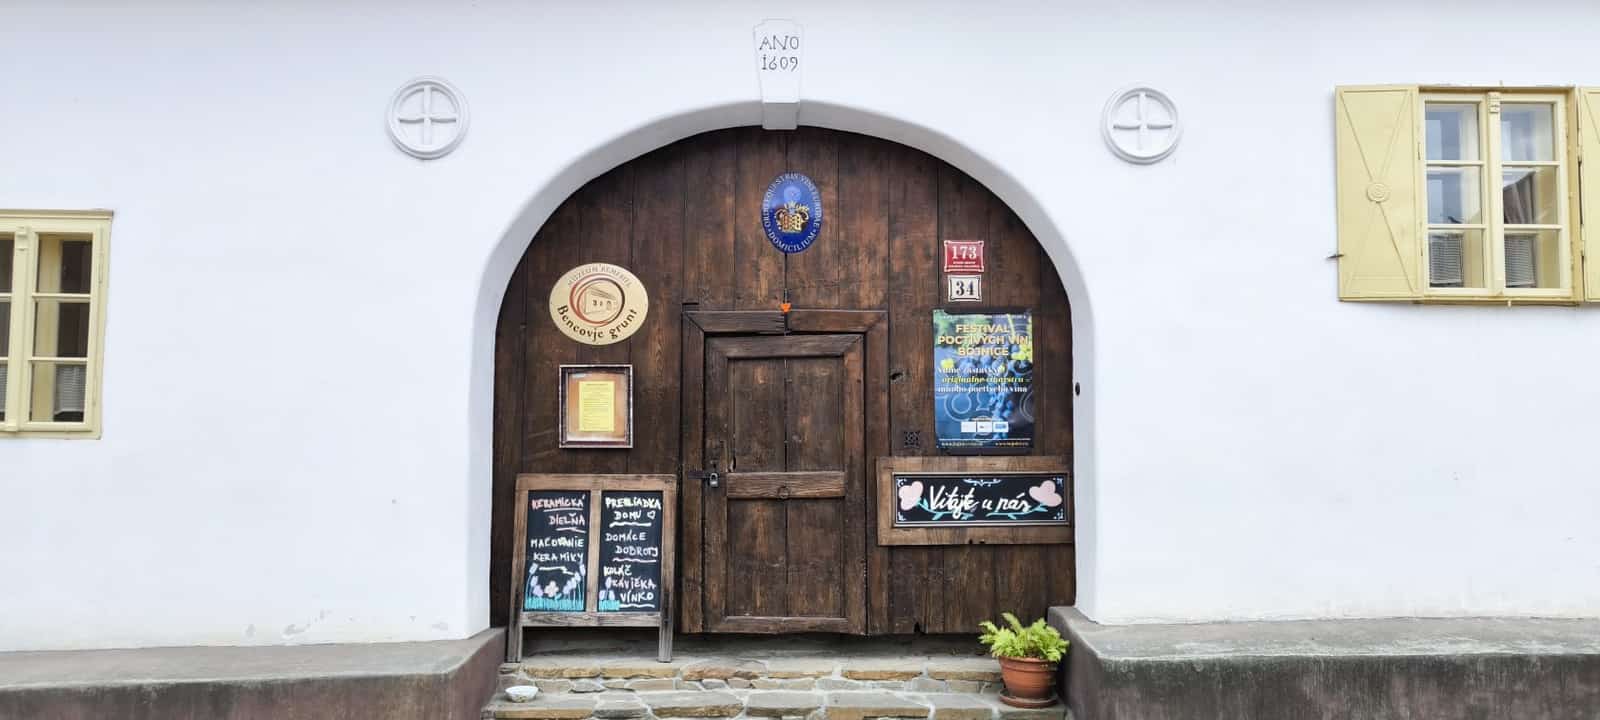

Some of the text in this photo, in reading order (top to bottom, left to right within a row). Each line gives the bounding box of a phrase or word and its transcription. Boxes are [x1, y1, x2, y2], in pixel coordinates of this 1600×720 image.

[759, 35, 799, 50] ANO
[762, 54, 798, 71] 1609
[768, 231, 817, 252] DOMICILIUM
[952, 246, 977, 259] 173
[956, 281, 974, 296] 34
[557, 305, 637, 341] Bencovje grunt
[955, 324, 1010, 333] FESTIVAL
[959, 346, 1009, 357] BOJNICE
[929, 485, 1030, 519] Vitajte u nás
[605, 530, 647, 542] DOMÁCE
[620, 590, 654, 602] VÍNKO
